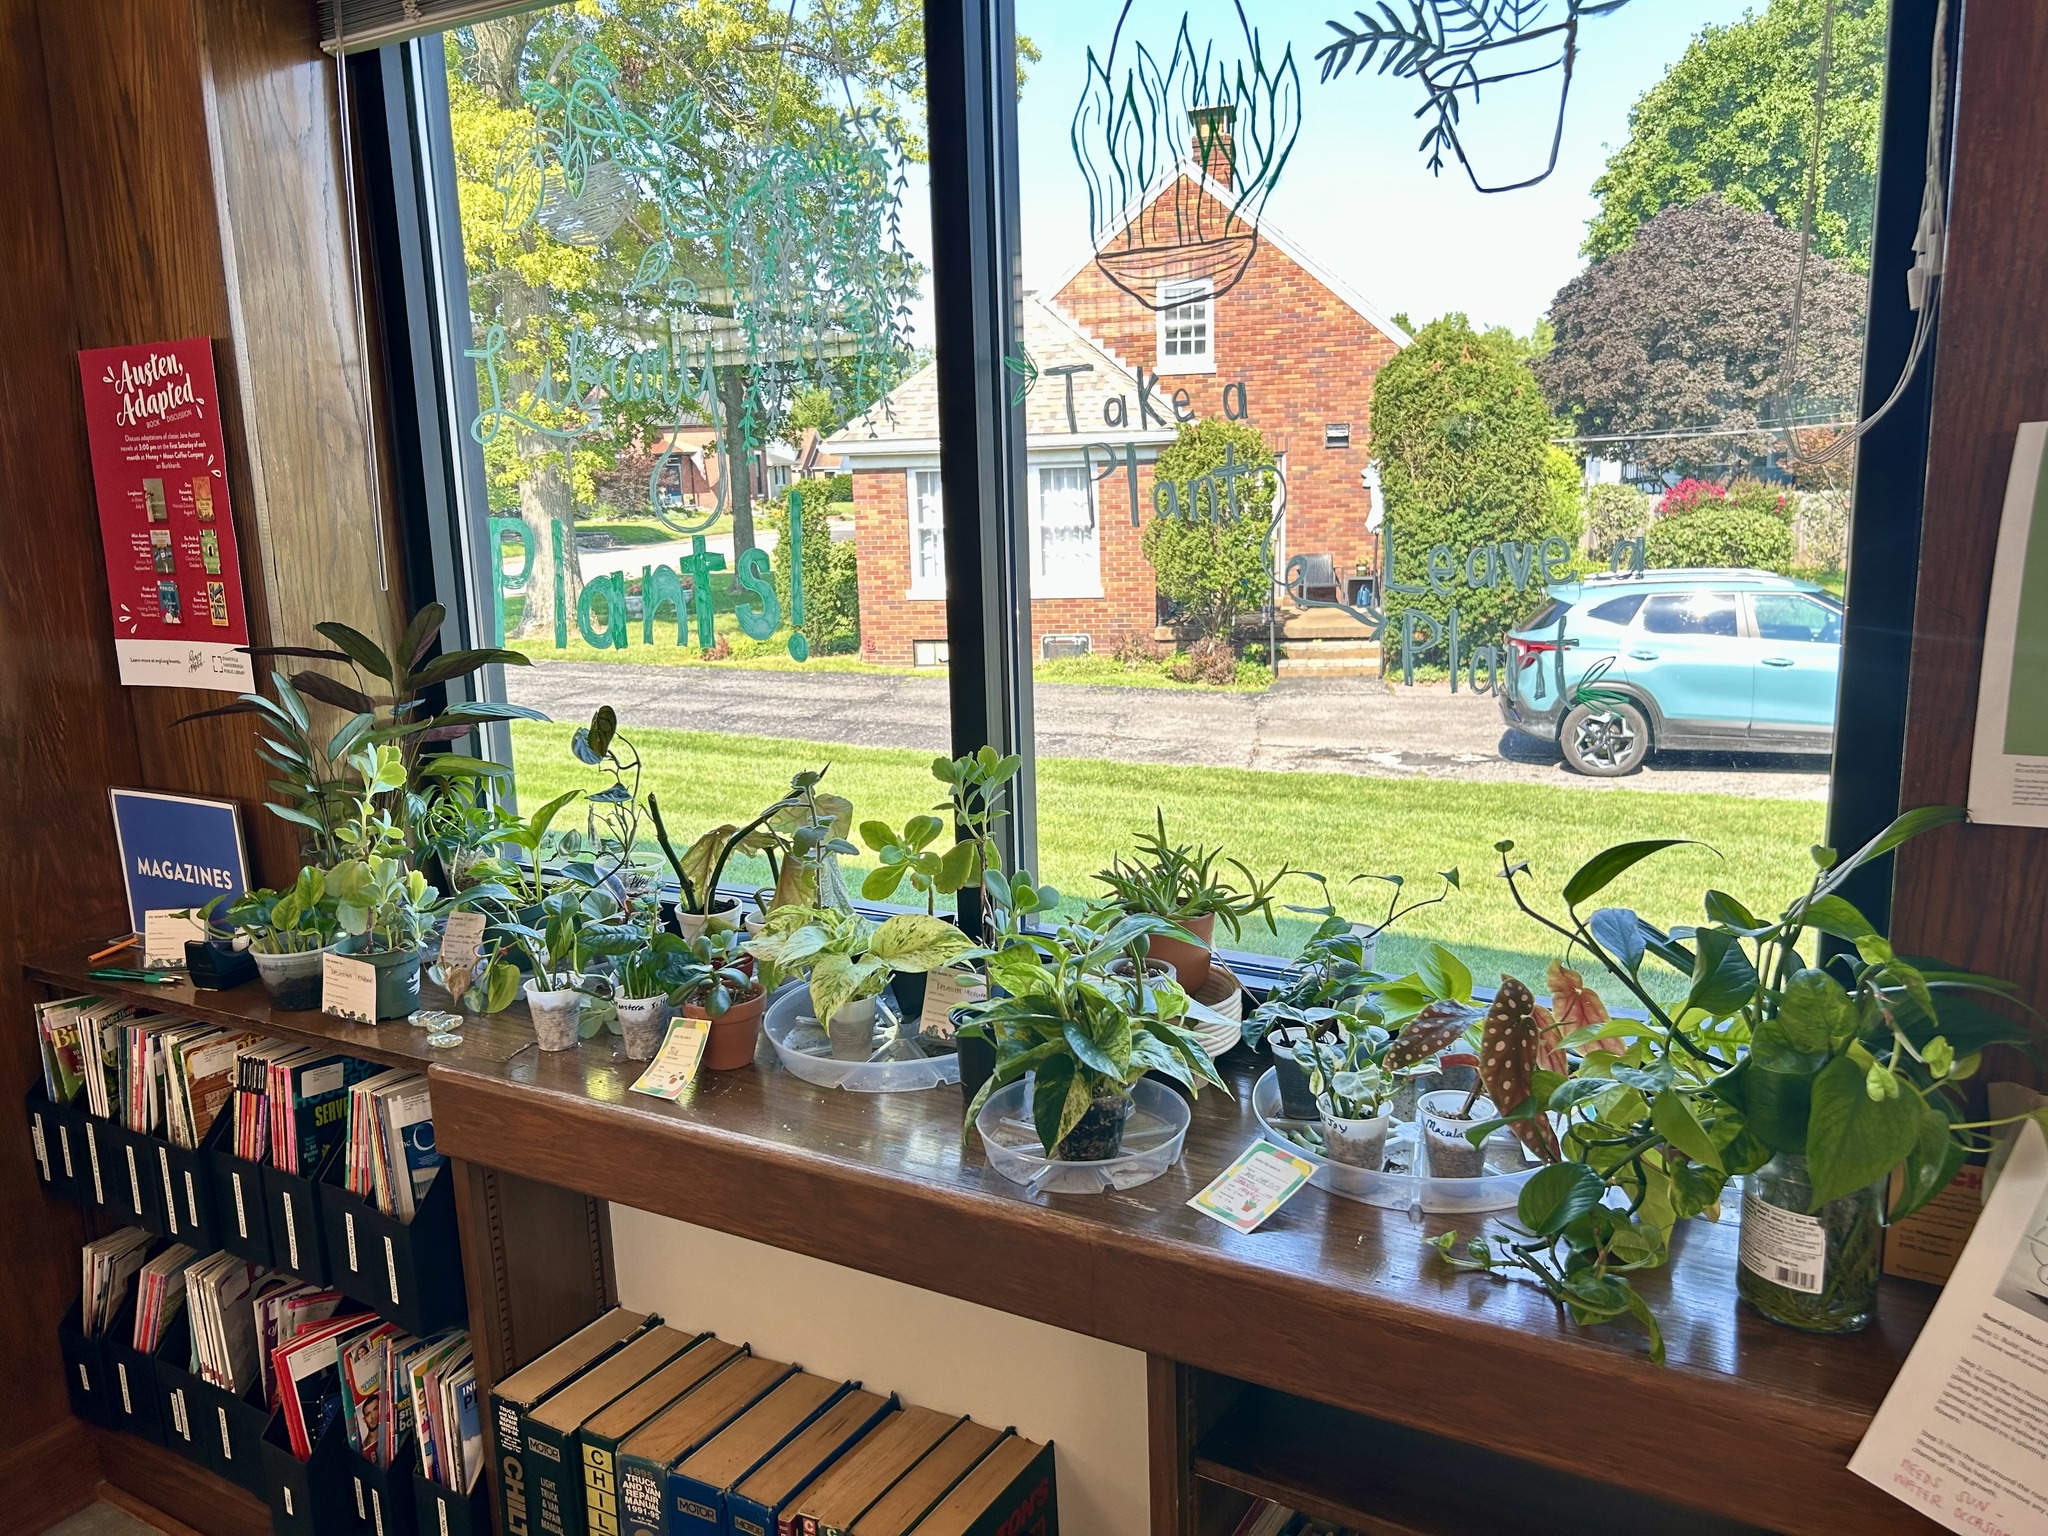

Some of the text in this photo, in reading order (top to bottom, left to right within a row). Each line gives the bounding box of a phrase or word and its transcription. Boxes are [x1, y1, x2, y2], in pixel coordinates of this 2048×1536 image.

[115, 353, 183, 394] Austen,
[116, 372, 195, 427] Adapted
[1044, 364, 1248, 433] Take a
[146, 409, 192, 428] BOOK DISCUSSION
[464, 324, 727, 533] Library
[141, 434, 162, 442] adaptations
[178, 441, 194, 450] Saturday
[146, 453, 158, 462] Honey
[188, 451, 204, 460] Company
[1084, 442, 1248, 529] Plant
[1384, 524, 1646, 595] Leave a
[490, 490, 809, 663] Plants!
[137, 856, 233, 890] MAGAZINES
[127, 1148, 135, 1182] CONSUMER
[234, 1176, 242, 1212] EVANSVILLE
[388, 1264, 396, 1299] BEAUTIFUL
[1976, 1324, 2029, 1355] Step Build up
[1983, 1312, 2044, 1347] Bearded Iris Basic
[1972, 1334, 1985, 1342] you
[1986, 1340, 2002, 1352] have
[1956, 1364, 2024, 1404] 75%, leaving the top
[1960, 1356, 1976, 1368] Step
[1984, 1369, 2008, 1384] Center
[2008, 1382, 2021, 1392] the
[499, 1406, 515, 1414] TRUCK
[1938, 1398, 1966, 1416] planting
[1946, 1382, 1972, 1398] surface
[1982, 1400, 1994, 1409] the
[2024, 1420, 2036, 1431] The
[1950, 1374, 2044, 1424] planting too close together
[499, 1420, 519, 1432] MANUAL
[500, 1416, 518, 1426] REPAIR
[1934, 1406, 1960, 1424] flowers.
[1942, 1390, 1966, 1404] spread
[1966, 1402, 1978, 1412] the
[1979, 1410, 2000, 1422] roots
[2000, 1420, 2012, 1429] out
[2012, 1426, 2035, 1442] below
[530, 1440, 559, 1460] MOTOR
[1921, 1430, 1936, 1442] Step
[1946, 1443, 1962, 1456] Firm
[1963, 1453, 1974, 1462] the
[1976, 1461, 1991, 1471] soil
[1990, 1468, 2018, 1486] around
[2017, 1482, 2030, 1493] the
[540, 1477, 556, 1491] LIGHT
[626, 1473, 656, 1489] TRUCK
[628, 1466, 652, 1480] 1995
[1900, 1458, 1990, 1512] NEEDS SUN
[1912, 1447, 1936, 1464] chance
[1946, 1466, 1970, 1483] strong
[1969, 1480, 1996, 1497] growth.
[1916, 1438, 1956, 1464] thoroughly.
[1958, 1460, 1972, 1472] This
[1974, 1470, 1992, 1484] helps
[2002, 1486, 2030, 1504] remove
[2032, 1502, 2046, 1514] any
[541, 1488, 558, 1502] TRUCK
[591, 1450, 608, 1536] CHIL
[623, 1481, 661, 1499] AND VAN
[626, 1488, 658, 1504] REPAIR
[1894, 1472, 1944, 1510] WATER
[542, 1499, 558, 1513] & VAN
[542, 1509, 561, 1524] REPAIR
[625, 1496, 661, 1514] MANUAL
[627, 1505, 660, 1520] 1991-95
[680, 1500, 715, 1521] MOTOR
[541, 1519, 564, 1536] MANUAL
[736, 1518, 764, 1536] MOTOR
